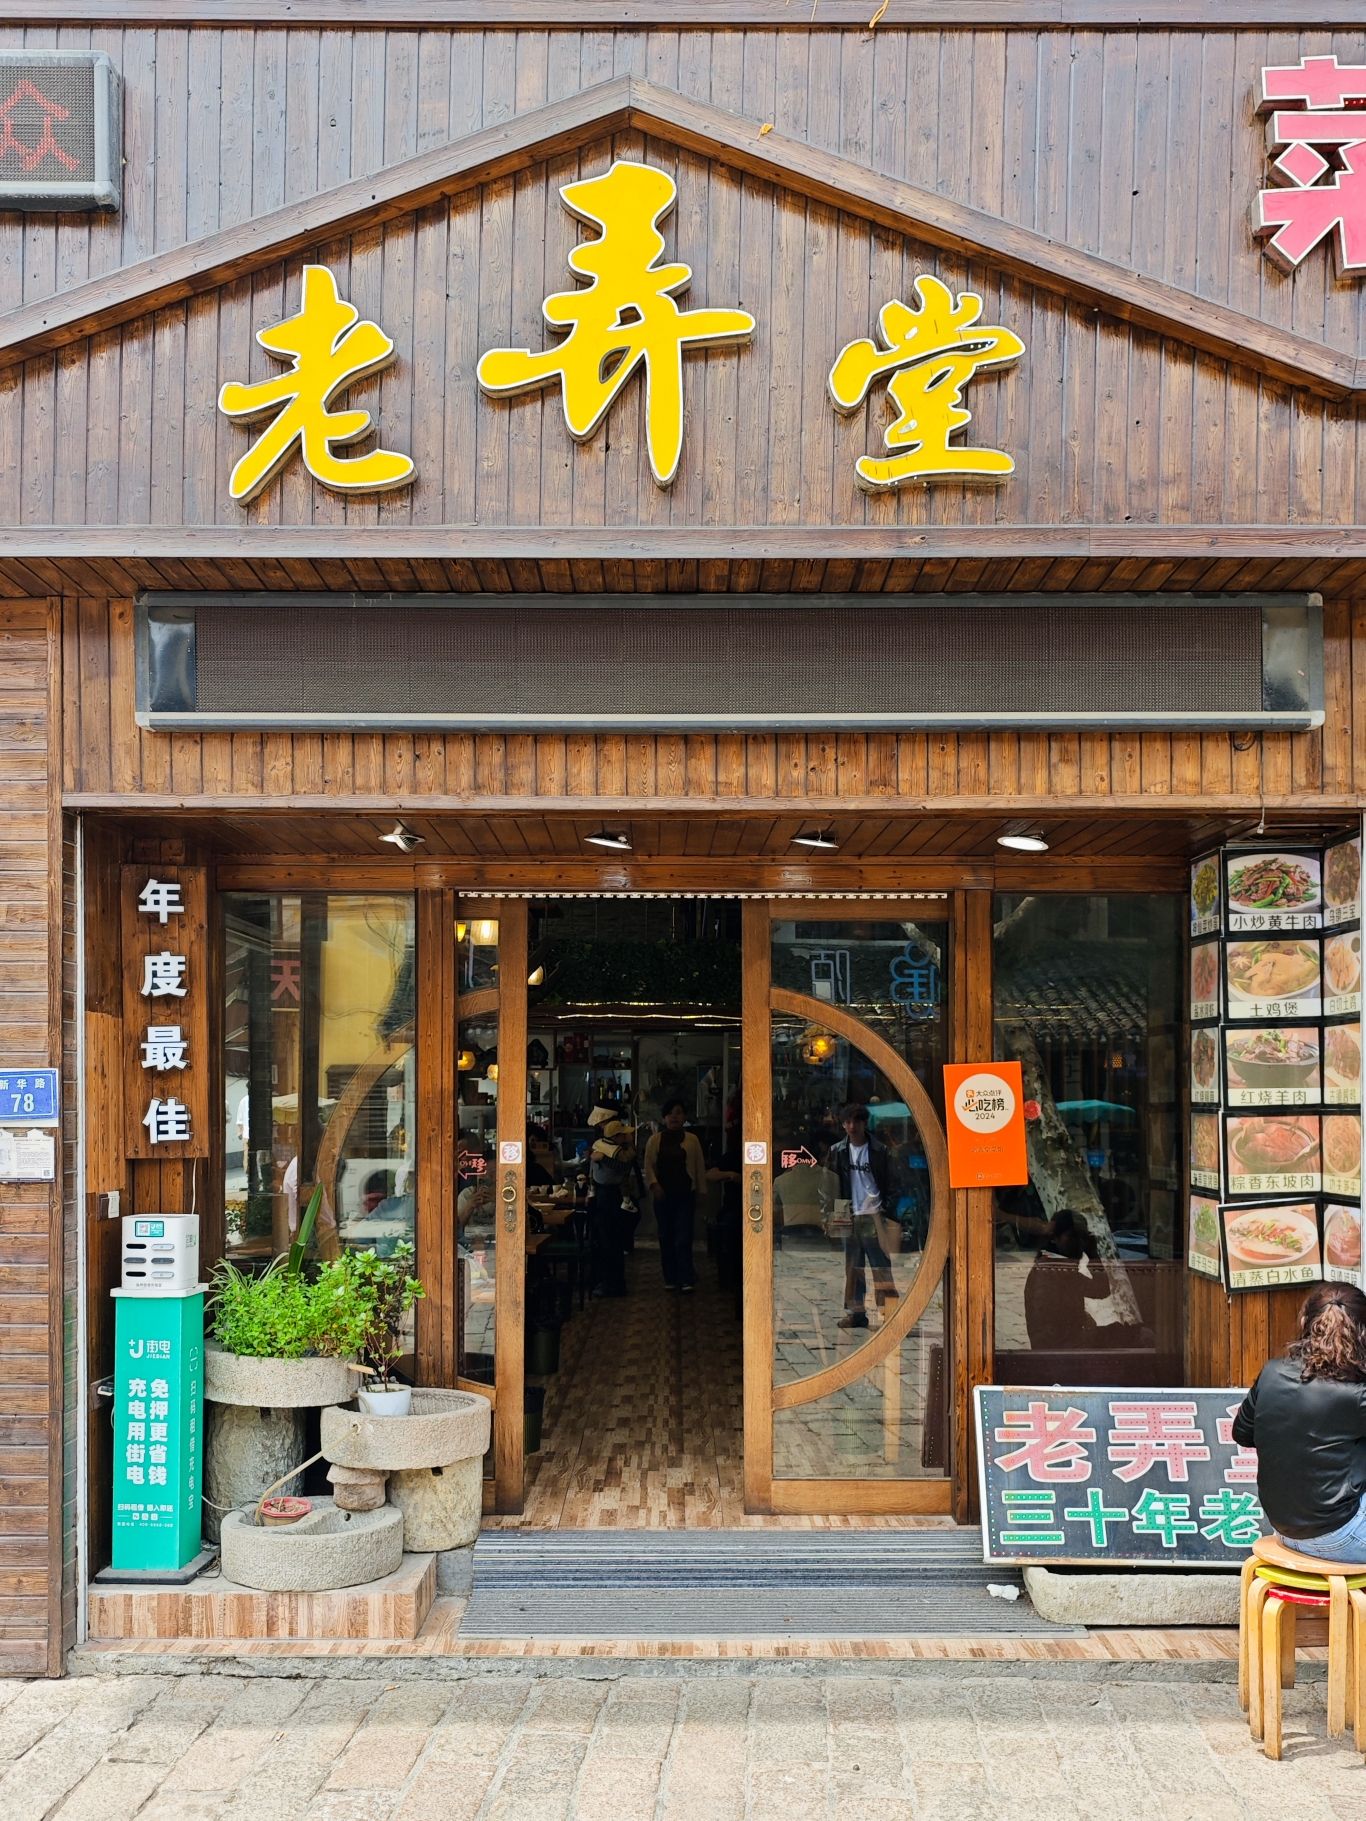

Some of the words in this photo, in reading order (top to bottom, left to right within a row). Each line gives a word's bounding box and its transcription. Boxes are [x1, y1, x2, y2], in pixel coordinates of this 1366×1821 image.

[218, 160, 1027, 500] 老弄堂
[1233, 914, 1317, 930] 小炒黄牛肉
[138, 878, 191, 1144] 年度最佳
[1250, 1001, 1299, 1017] 土鸡煲
[0, 1077, 46, 1090] 新华路
[976, 1089, 1002, 1097] 大众点评
[1240, 1089, 1307, 1105] 红烧羊肉
[10, 1093, 35, 1113] 78
[961, 1097, 1005, 1112] 必吃榜
[975, 1112, 995, 1120] 2024
[1232, 1266, 1315, 1287] 清蒸白水鱼
[125, 1378, 147, 1485] 充电用街电
[148, 1378, 169, 1486] 免押更省钱
